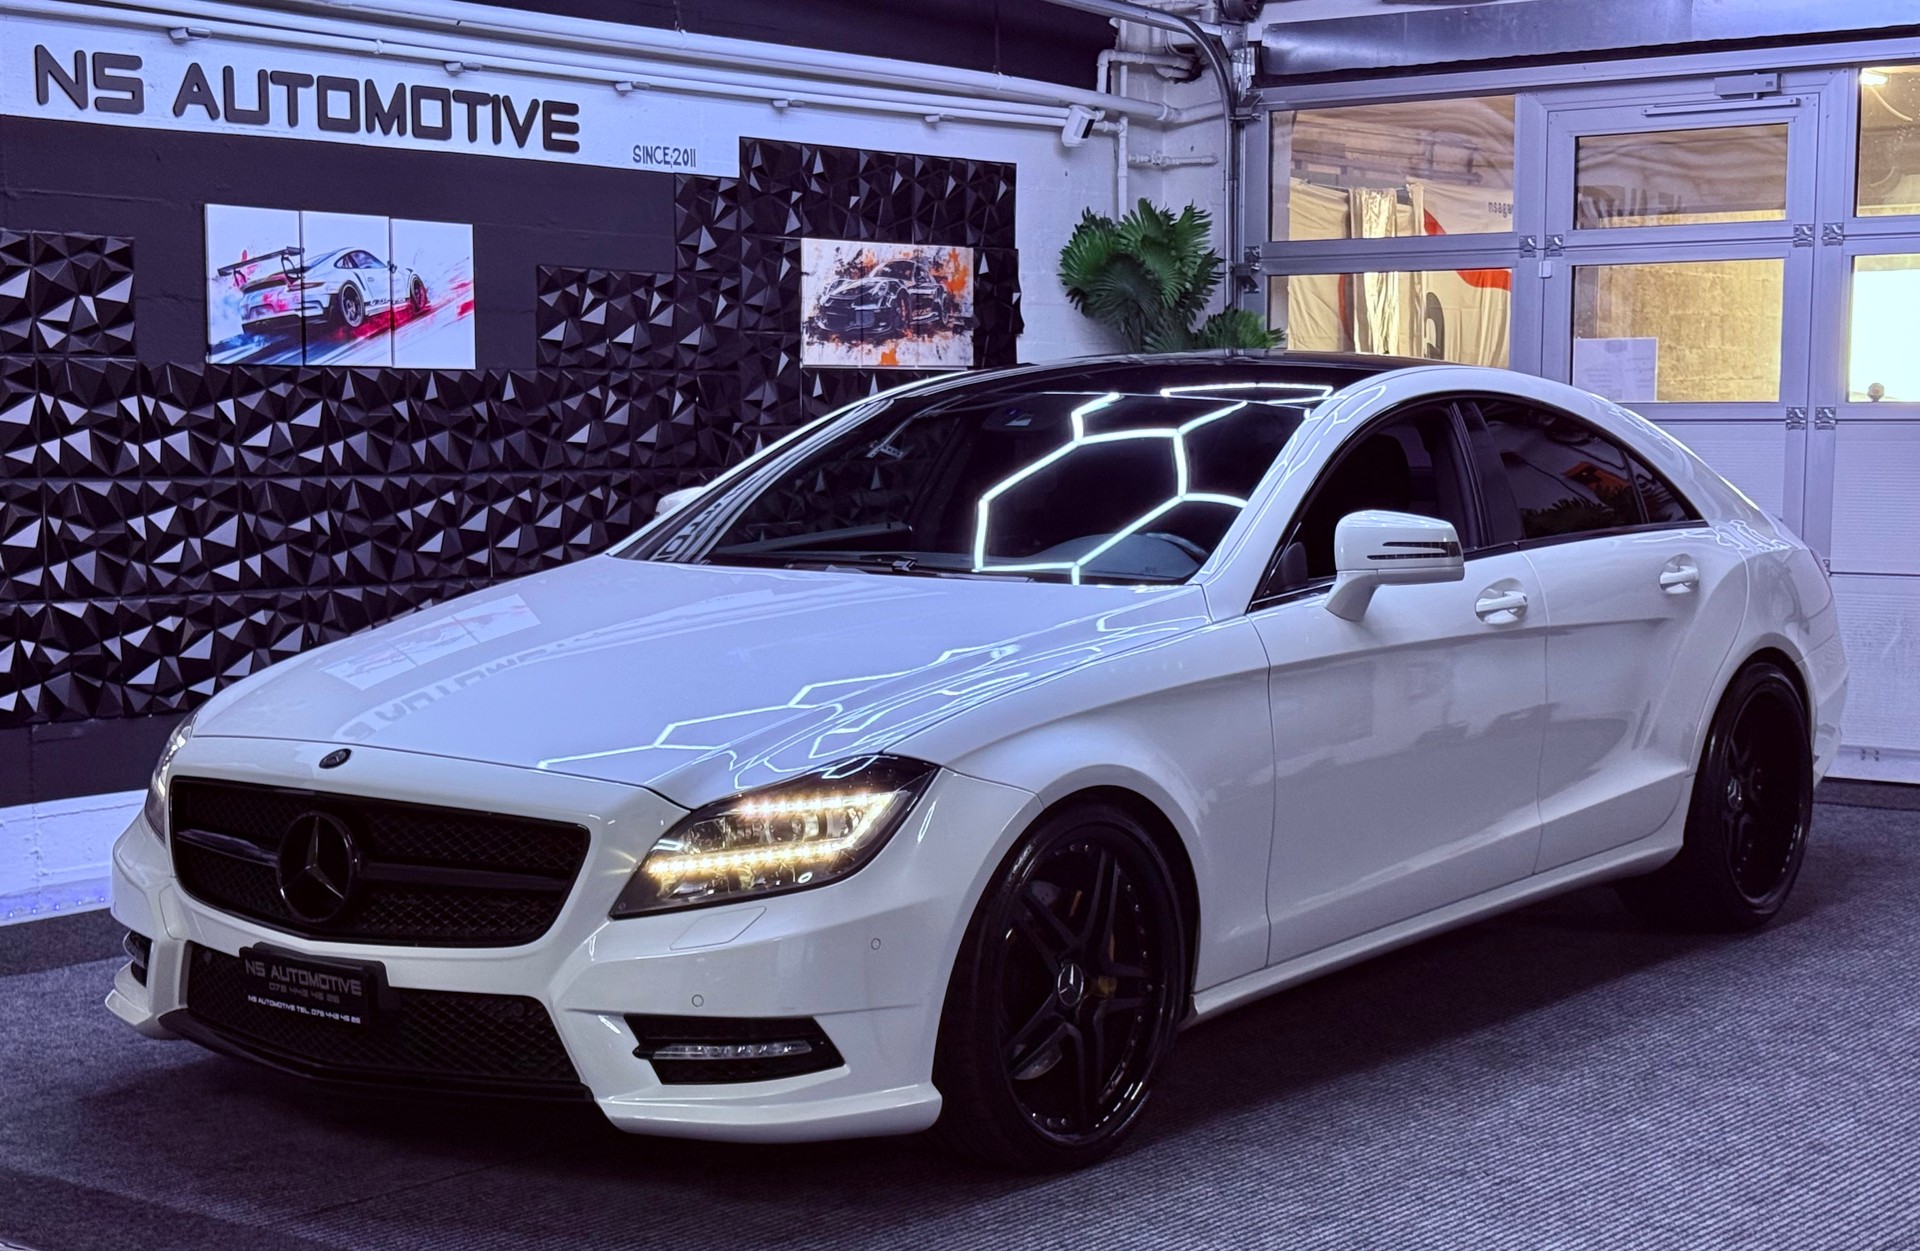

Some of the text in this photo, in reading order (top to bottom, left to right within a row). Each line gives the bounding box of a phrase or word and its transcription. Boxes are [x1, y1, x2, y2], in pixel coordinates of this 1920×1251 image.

[34, 44, 580, 153] NS AUTOMOTIVE
[246, 959, 361, 996] NS AUTOMOTIVE
[248, 995, 257, 1003] NS
[258, 997, 295, 1011] AUTOMOTIVE
